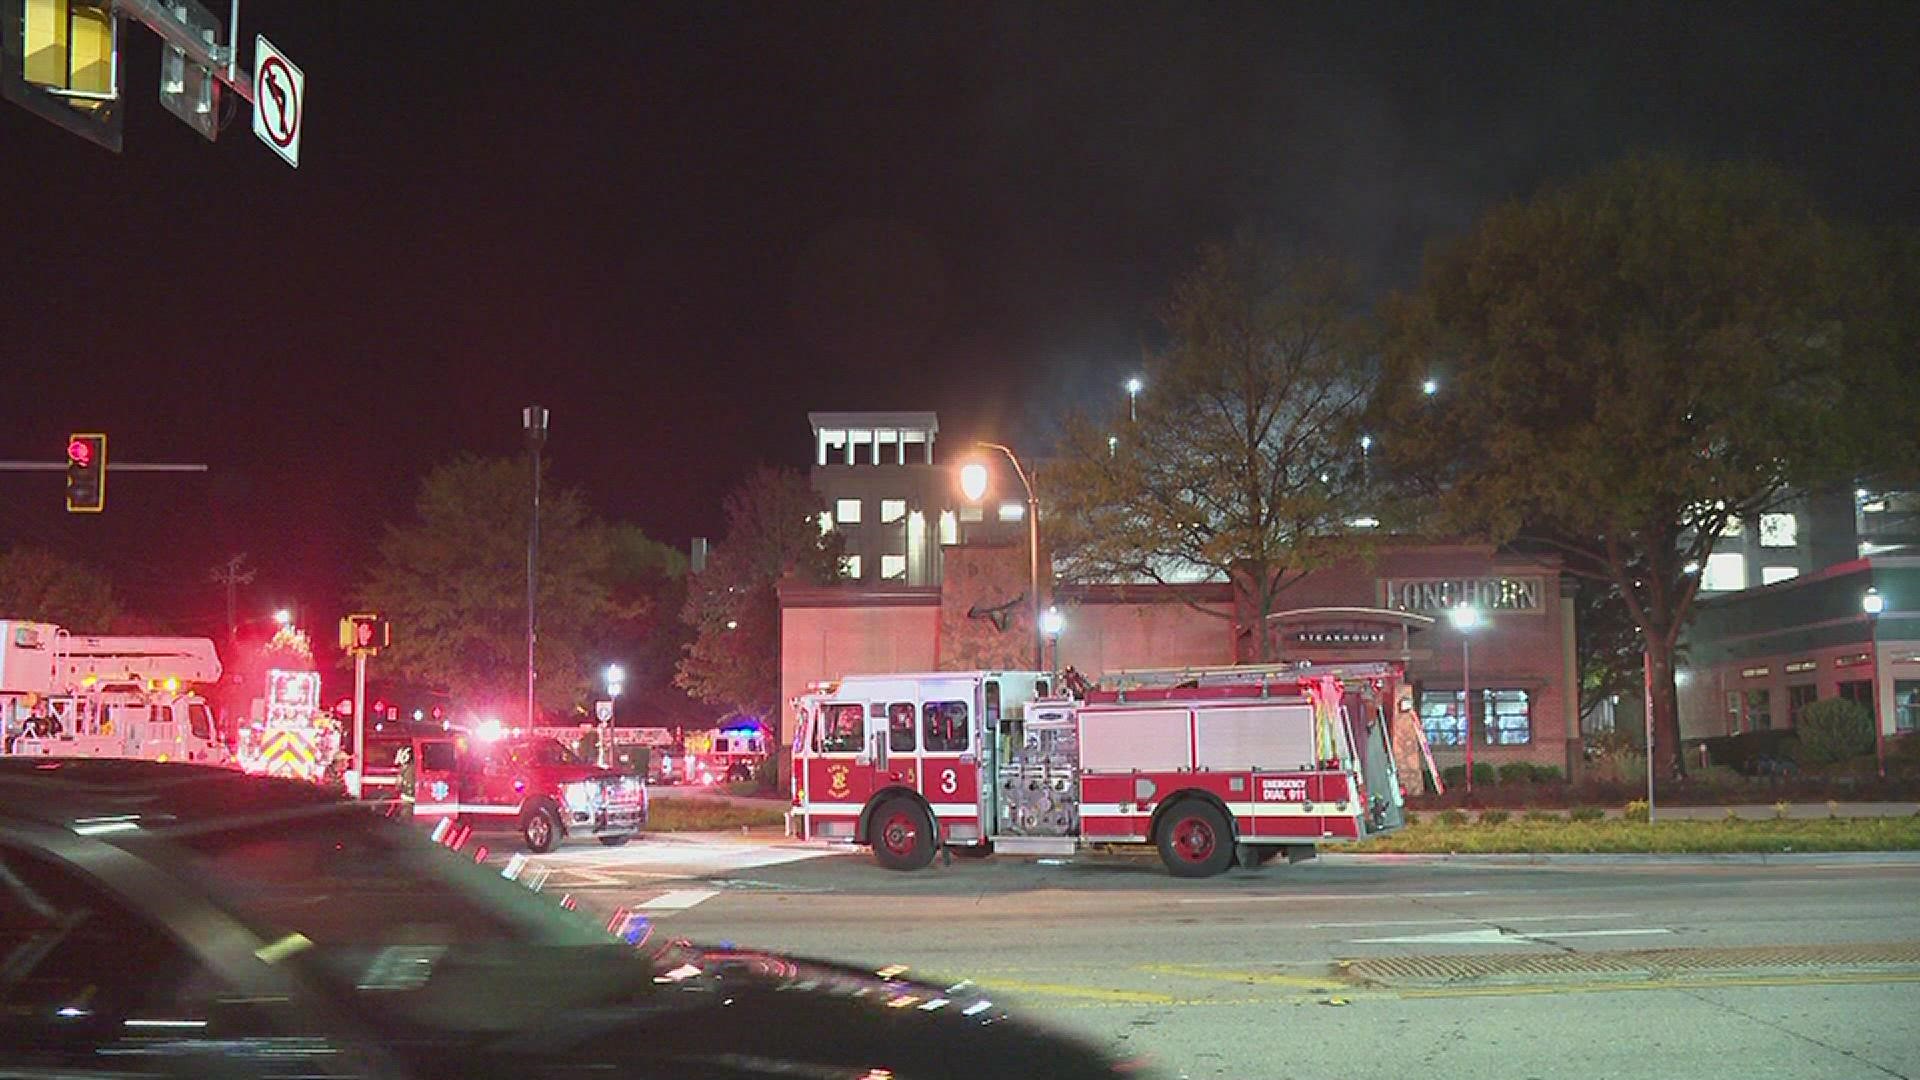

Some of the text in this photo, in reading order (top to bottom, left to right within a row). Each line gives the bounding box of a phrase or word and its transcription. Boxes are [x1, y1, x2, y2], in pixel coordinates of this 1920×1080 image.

[1387, 580, 1537, 610] LONGHORN
[1300, 633, 1385, 642] STEAKHOUSE
[940, 768, 958, 794] 3
[1262, 789, 1306, 800] DIAL 911
